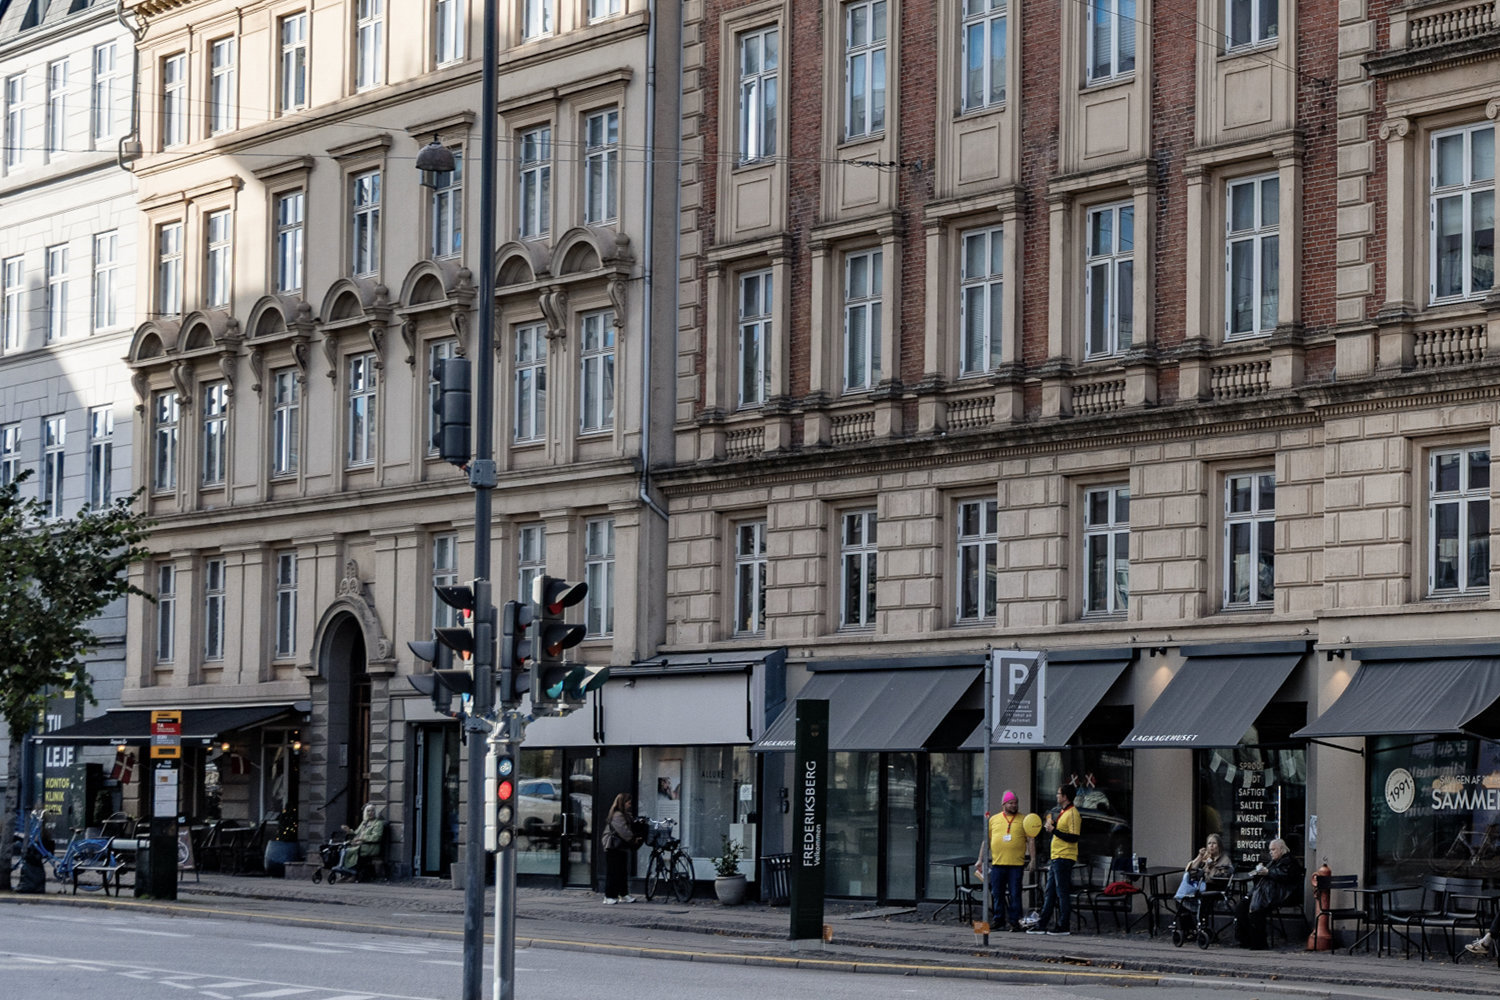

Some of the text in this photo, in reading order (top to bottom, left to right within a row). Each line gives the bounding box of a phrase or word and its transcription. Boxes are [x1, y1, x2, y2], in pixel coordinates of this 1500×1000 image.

[1008, 663, 1029, 695] P
[1004, 729, 1033, 740] Zone
[1131, 734, 1199, 742] LAGKAGEHUSET
[46, 746, 75, 767] LEJE
[1238, 788, 1266, 797] SAFTIGT
[1389, 777, 1412, 802] 1991
[45, 791, 65, 802] KLINIK
[1239, 801, 1263, 810] SALTET
[803, 760, 817, 866] FREDERIKSBERG
[1236, 814, 1267, 823] KVÆRNET
[1240, 827, 1263, 836] RISTET
[814, 824, 822, 866] Velkommen
[1236, 840, 1267, 850] BRYGGET
[1242, 853, 1260, 862] BAGT
